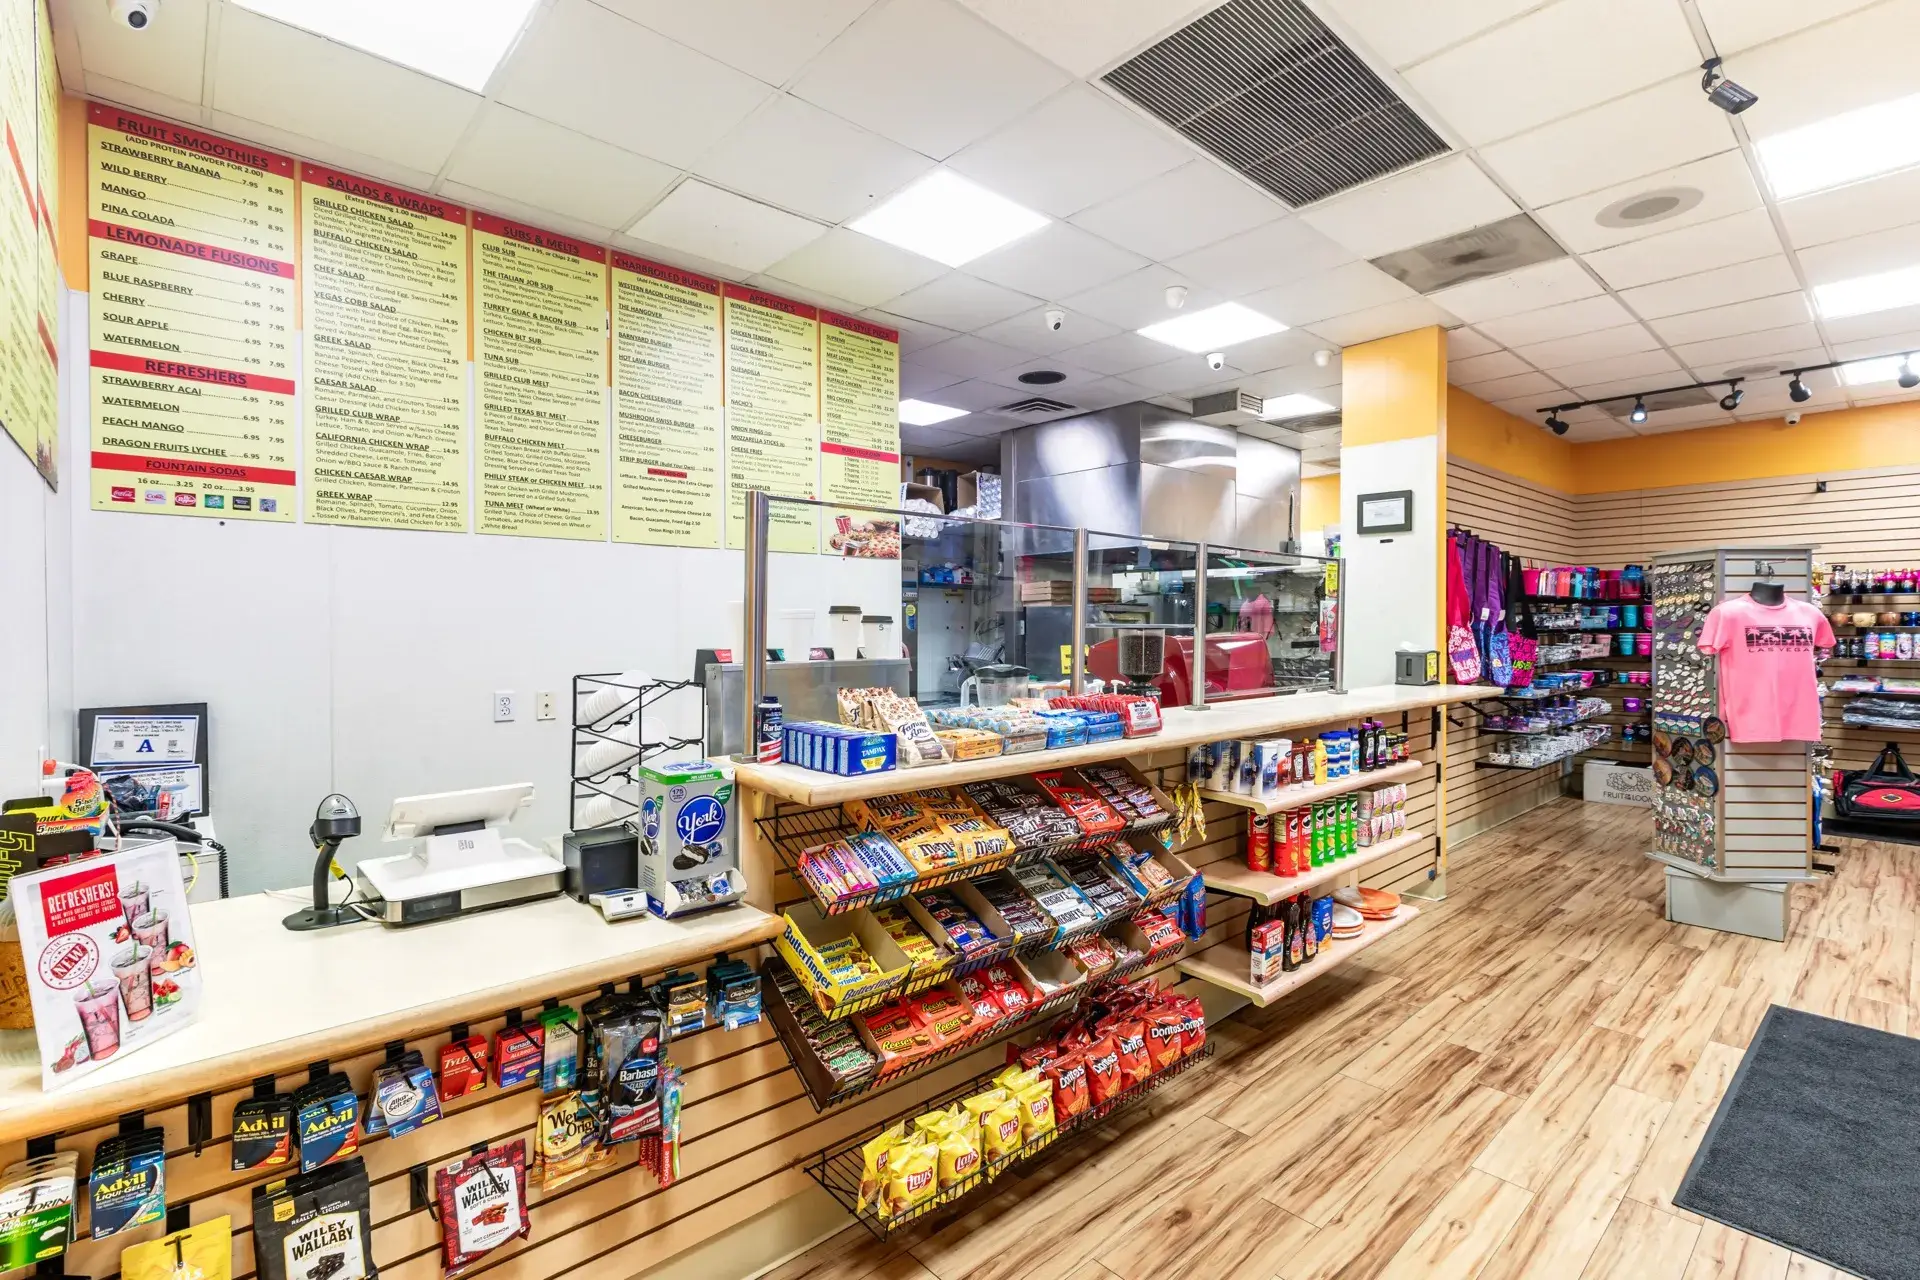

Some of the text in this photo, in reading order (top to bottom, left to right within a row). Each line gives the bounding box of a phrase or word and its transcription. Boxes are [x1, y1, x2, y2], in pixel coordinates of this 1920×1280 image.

[117, 116, 269, 169] FRUIT SMOOTHIES
[101, 141, 284, 196] STRAWBERRY BANANA 7.95 8.95
[125, 135, 264, 178] (ADD PROTEIN POWDER FOR 2.00)
[101, 161, 284, 215] WILD BERRY 7.95 8.95
[327, 176, 444, 217] SALADS & WRAPS
[101, 182, 284, 233] MANGO 7.95 8.95
[313, 197, 457, 240] GRILLED CHICKEN SALAD 14.95
[345, 194, 428, 222] (Extra Dressing 1.00 each)
[101, 202, 284, 252] PINA COLADA 7.95 8.95
[503, 226, 579, 254] SUBS & MELTS
[106, 225, 280, 274] LEMONADE FUSIONS
[101, 250, 285, 295] GRAPE 6.95 7.95
[615, 257, 716, 293] CHARBROILED BURGER
[103, 271, 285, 314] BLUE RASPBERRY 6.95 7.95
[103, 291, 285, 333] CHERRY 6.95 7.95
[831, 317, 852, 328] VEGAS
[103, 312, 285, 350] SOUR APPLE 6.95 7.95
[103, 332, 285, 369] WATERMELON 6.95 7.95
[145, 359, 247, 385] REFRESHERS
[102, 375, 285, 408] STRAWBERRY ACAI 6.95 7.95
[102, 395, 285, 426] WATERMELON 6.95 7.95
[102, 416, 285, 445] PEACH MANGO 6.95 7.95
[315, 431, 430, 451] CALIFORNIA CHICKEN WRAP
[619, 433, 662, 445] CHEESEBURGER
[731, 434, 779, 447] MOZZARELLA STICKS
[102, 436, 285, 463] DRAGON FRUITS LYCHEE 6.95 7.95
[145, 459, 246, 477] FOUNTAIN SODAS
[138, 477, 148, 485] 16
[176, 481, 194, 489] 3.25
[202, 482, 212, 490] 20
[238, 485, 255, 493] 3.95
[316, 490, 345, 499] GREEK
[346, 492, 373, 501] WRAP
[484, 500, 524, 509] TUNA MELT
[842, 614, 848, 622] L
[878, 623, 884, 631] S
[135, 738, 155, 753] A
[861, 746, 886, 756] TAMPAX
[1603, 791, 1625, 800] FRUIT
[677, 802, 720, 845] York
[809, 857, 830, 885] mentos
[827, 847, 847, 875] mentos
[872, 847, 896, 875] mentos
[47, 880, 115, 914] REFRESHERS!
[801, 863, 831, 906] mentos
[1040, 890, 1071, 908] HERSHEY'S
[1054, 908, 1084, 925] HERSHEY'S
[55, 945, 84, 978] NEW
[783, 924, 833, 990] Butterfinger
[842, 972, 905, 1001] Butterfinger
[922, 999, 947, 1013] Reese's
[935, 1017, 961, 1034] Reese's
[1151, 1024, 1182, 1039] Doritos
[882, 1037, 914, 1051] Reese's
[444, 1049, 486, 1069] TYLEOL
[1092, 1051, 1118, 1074] Doritos
[619, 1065, 658, 1082] Barbasol
[1059, 1063, 1085, 1089] Doritos
[388, 1095, 414, 1112] Seltzer
[390, 1093, 409, 1106] Alka-
[634, 1088, 643, 1102] 2
[235, 1116, 285, 1134] Advil
[305, 1107, 353, 1136] Advil
[662, 1150, 670, 1182] Colgate
[93, 1172, 148, 1198] Advil
[96, 1182, 146, 1202] LIQUI-GELS
[291, 1225, 354, 1261] WALLABY
[299, 1218, 347, 1243] WILEY
